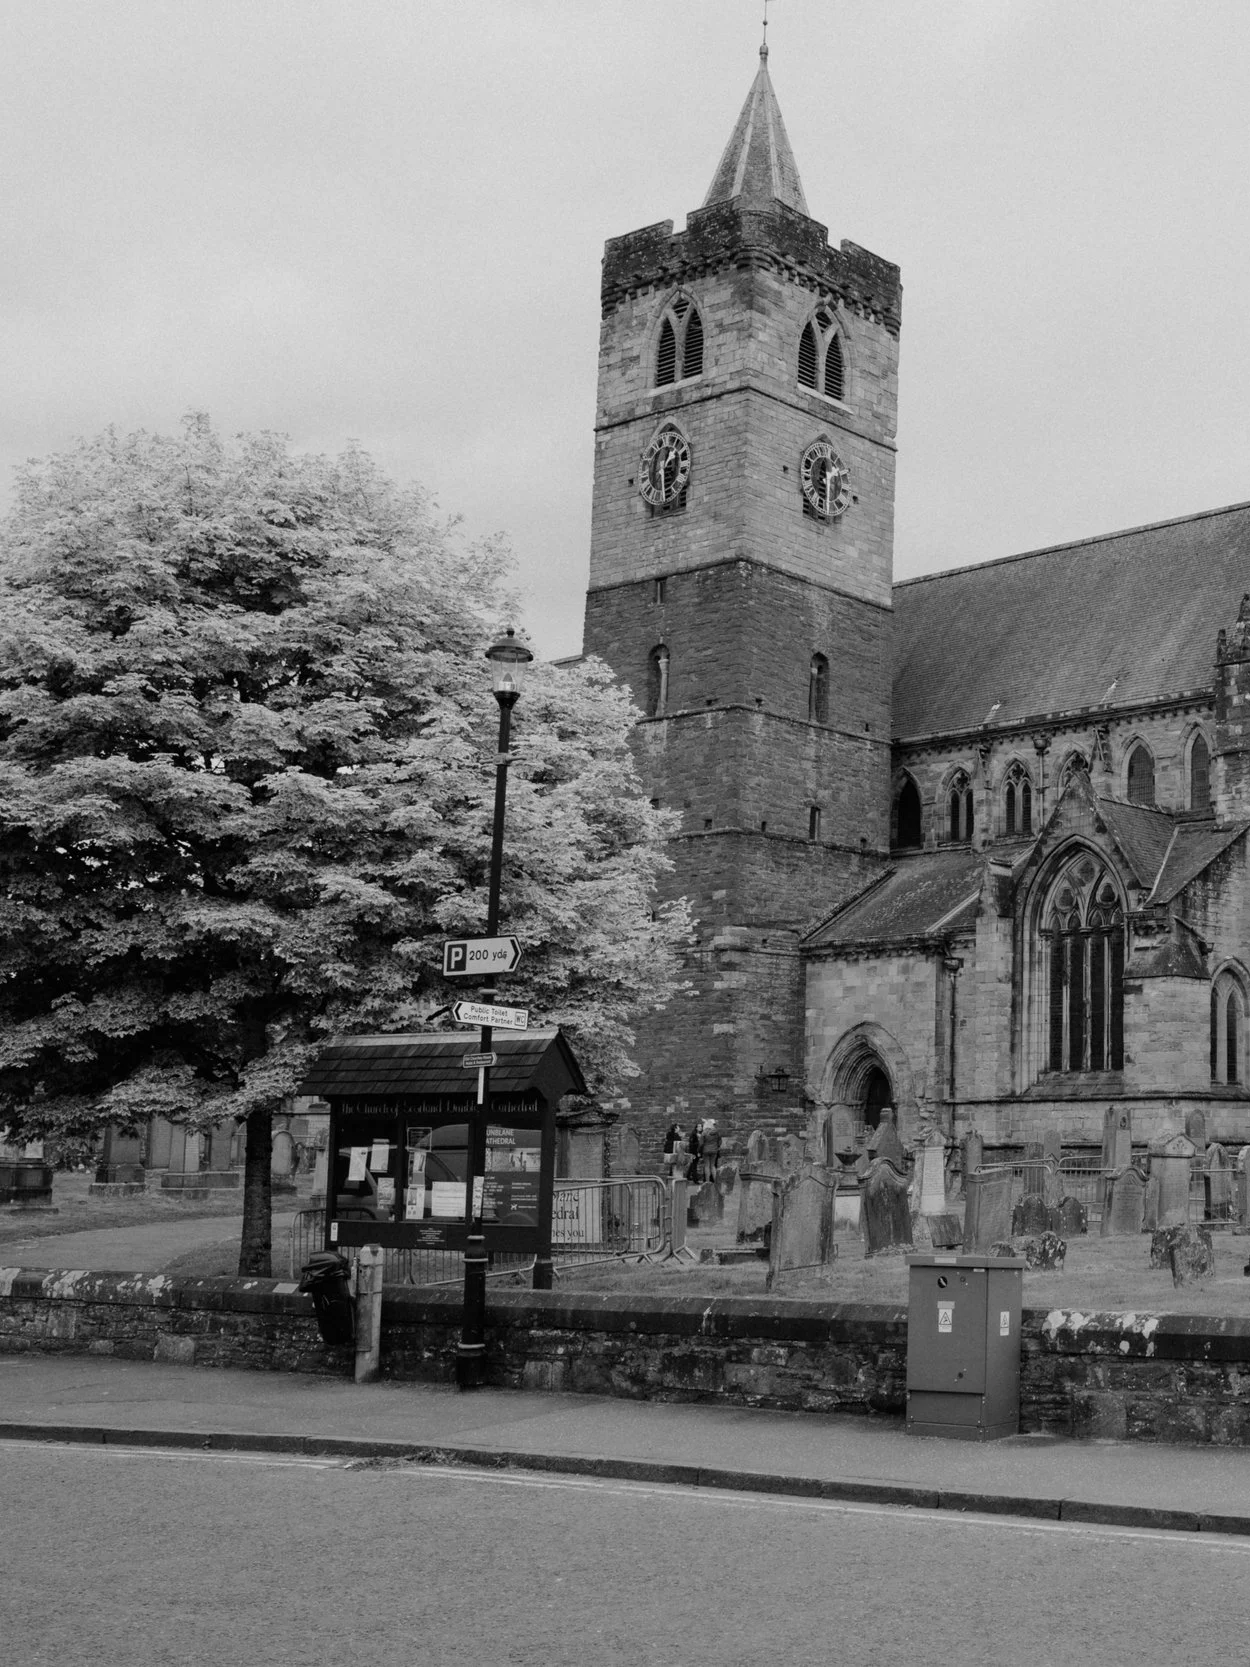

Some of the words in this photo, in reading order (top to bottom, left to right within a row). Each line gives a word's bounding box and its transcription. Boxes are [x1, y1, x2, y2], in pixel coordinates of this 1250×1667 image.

[450, 947, 463, 969] P
[469, 949, 489, 961] 200
[492, 948, 508, 961] yds
[470, 1005, 489, 1014] Public
[491, 1008, 508, 1017] Toilet
[463, 1012, 489, 1022] Comfort
[491, 1016, 513, 1025] Partner
[516, 1015, 525, 1024] WC
[486, 1129, 515, 1137] UNBLANE
[486, 1137, 516, 1145] ATHEDRAL
[567, 1230, 584, 1240] you
